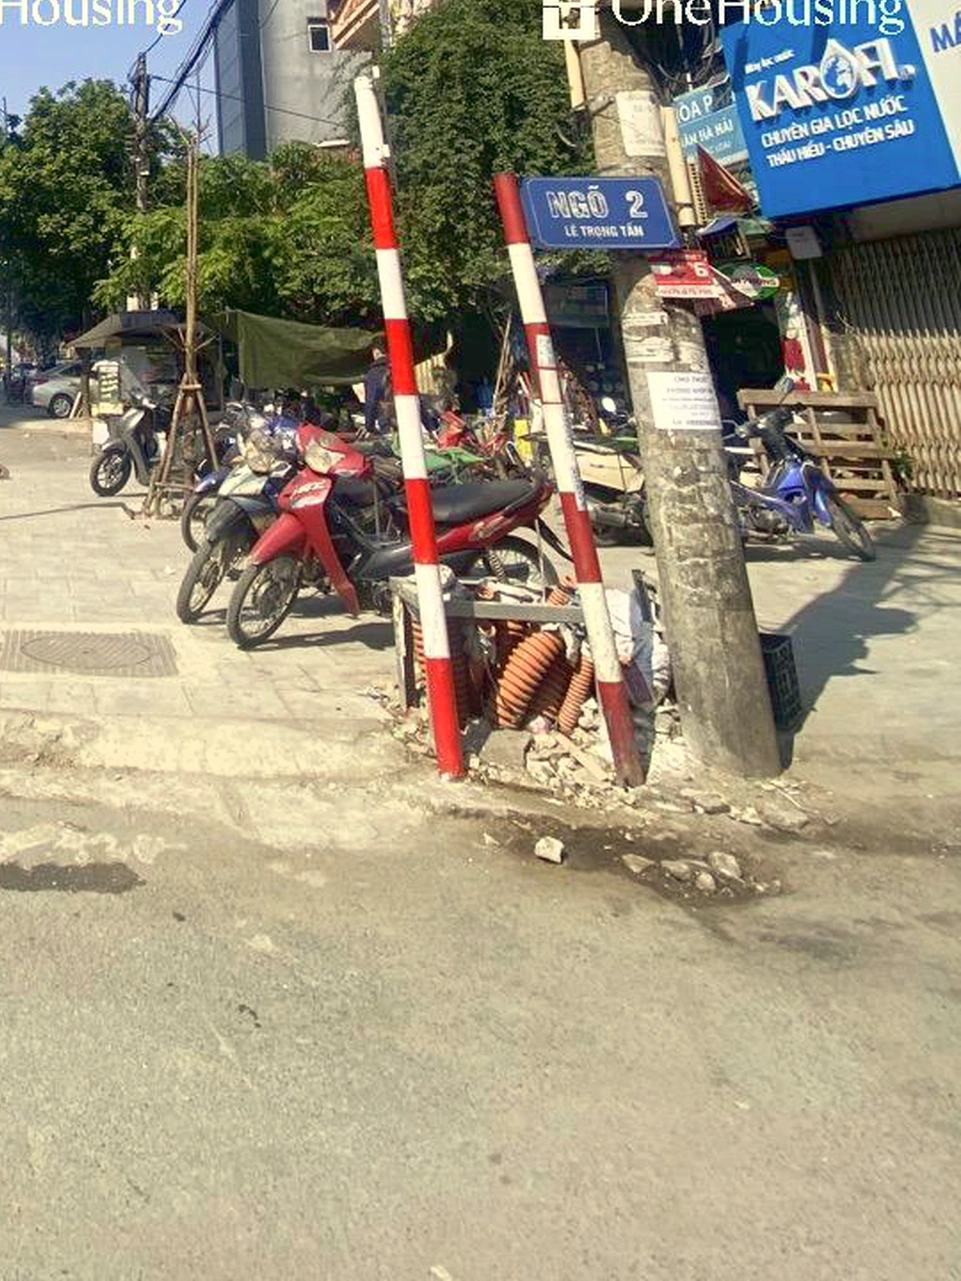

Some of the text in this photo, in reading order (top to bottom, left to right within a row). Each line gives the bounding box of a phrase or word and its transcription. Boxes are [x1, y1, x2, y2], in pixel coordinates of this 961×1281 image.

[810, 116, 834, 135] GIA
[835, 107, 864, 130] LỌC
[864, 94, 908, 121] NƯỚC
[884, 119, 915, 140] SÂU
[545, 185, 648, 218] NGÕ 2
[564, 221, 645, 239] LÊ TRỌNG TẤN
